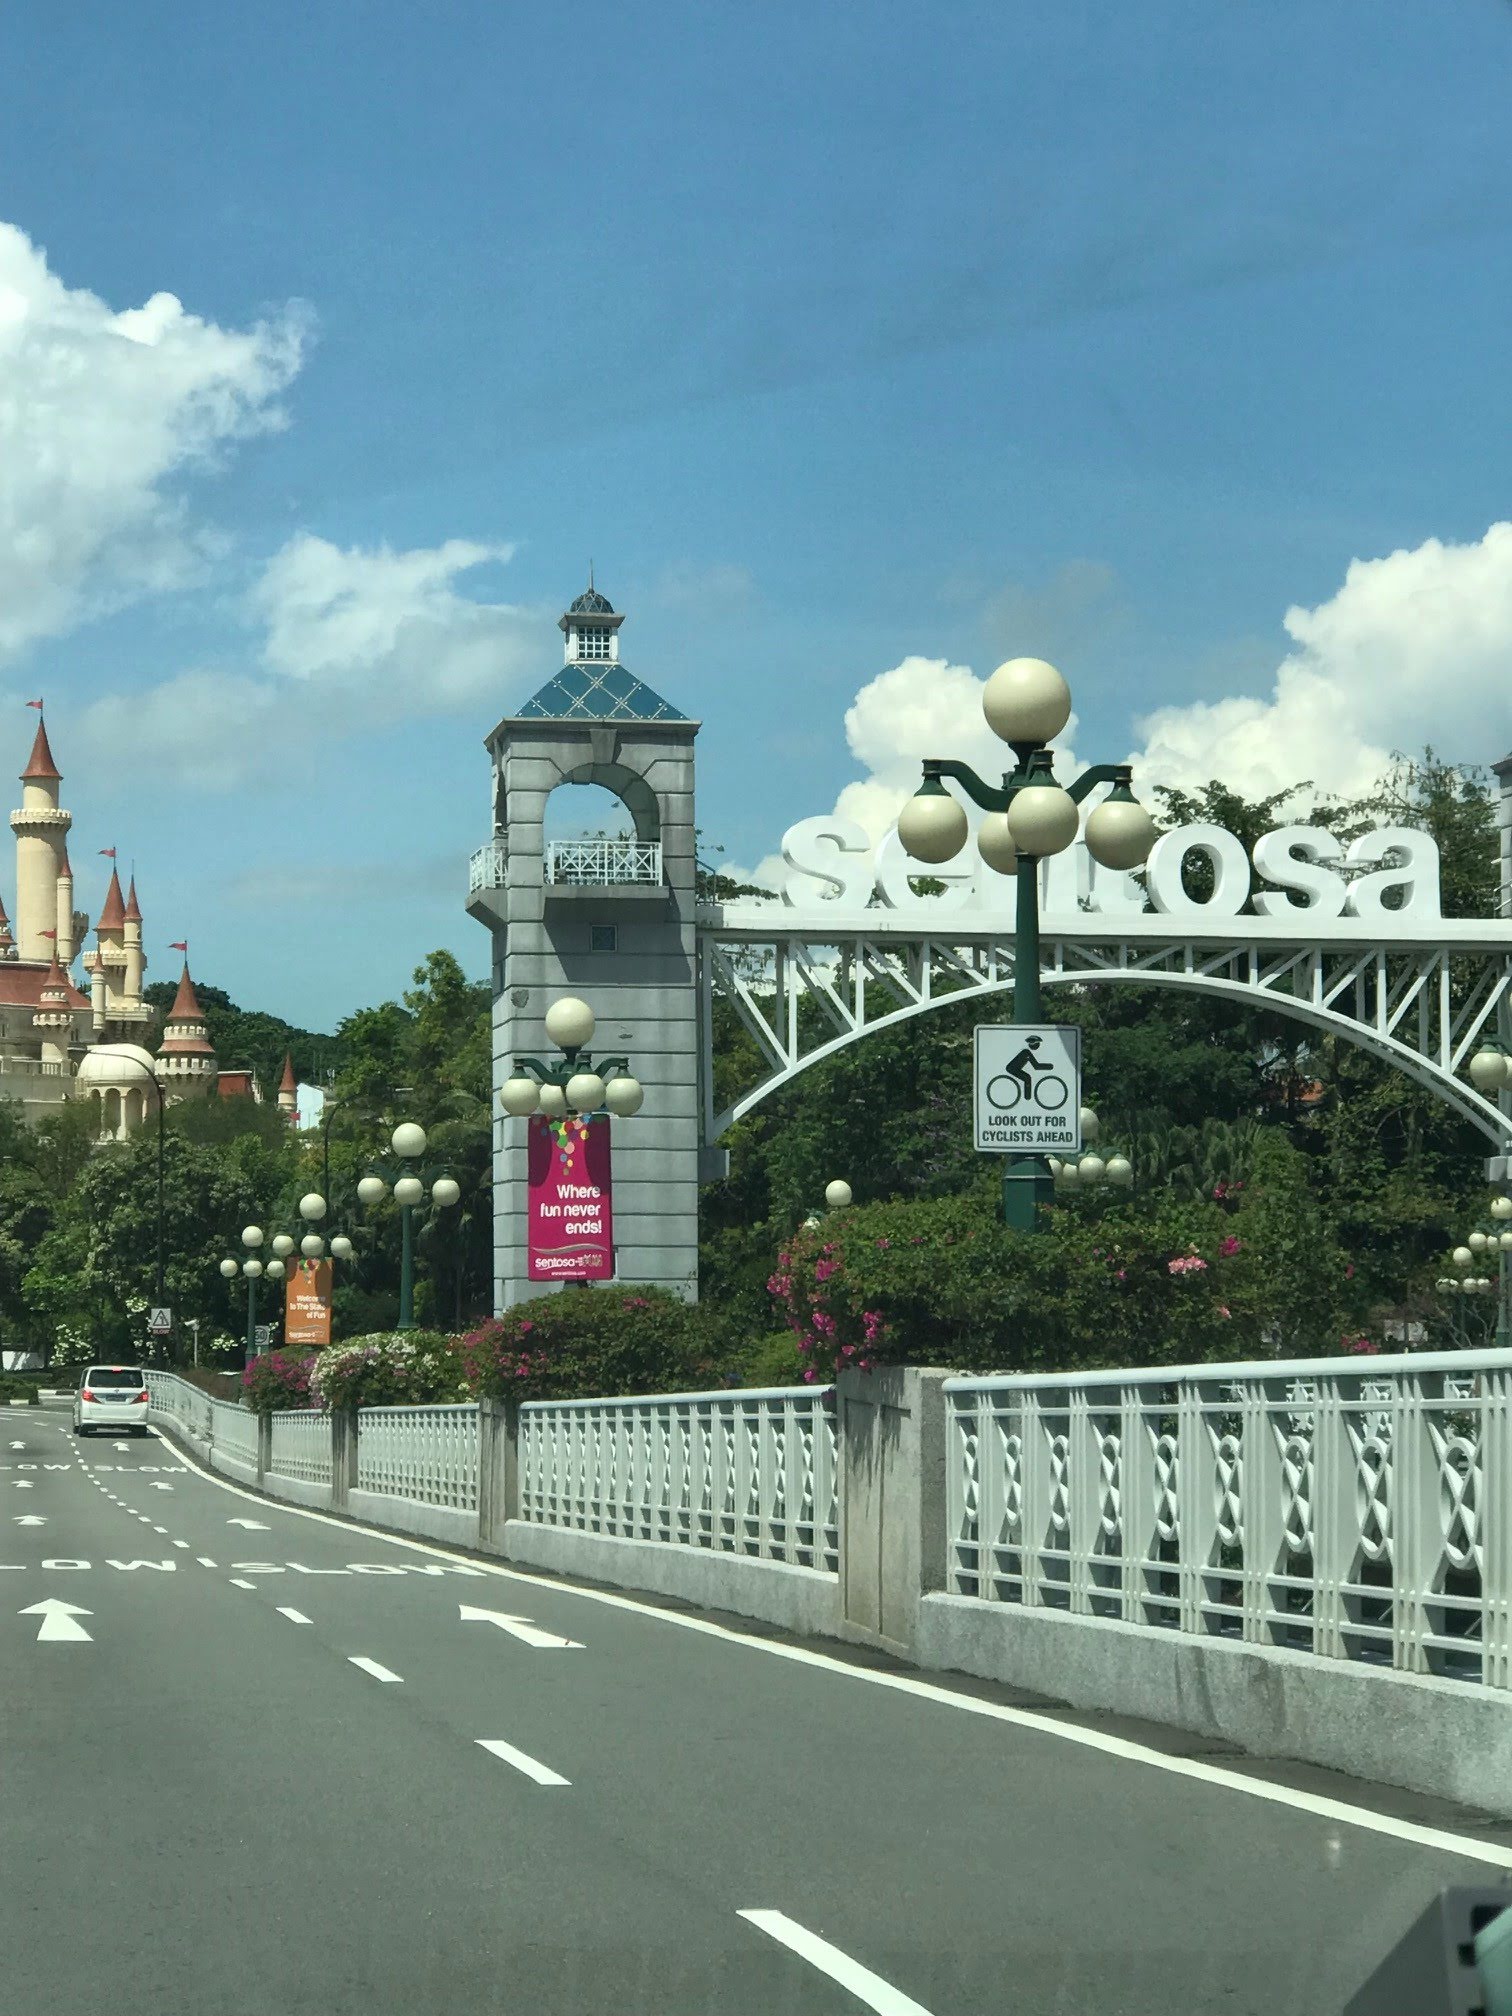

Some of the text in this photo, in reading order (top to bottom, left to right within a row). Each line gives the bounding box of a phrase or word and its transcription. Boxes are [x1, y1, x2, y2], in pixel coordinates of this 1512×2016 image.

[988, 1115, 1066, 1127] LOOK OUT FOR
[982, 1130, 1073, 1142] CYCLISTS AHEAD
[556, 1184, 601, 1199] Where
[540, 1203, 601, 1217] fun never
[565, 1219, 602, 1234] ends!
[94, 1464, 188, 1473] SLOW
[230, 1562, 487, 1577] SLOW
